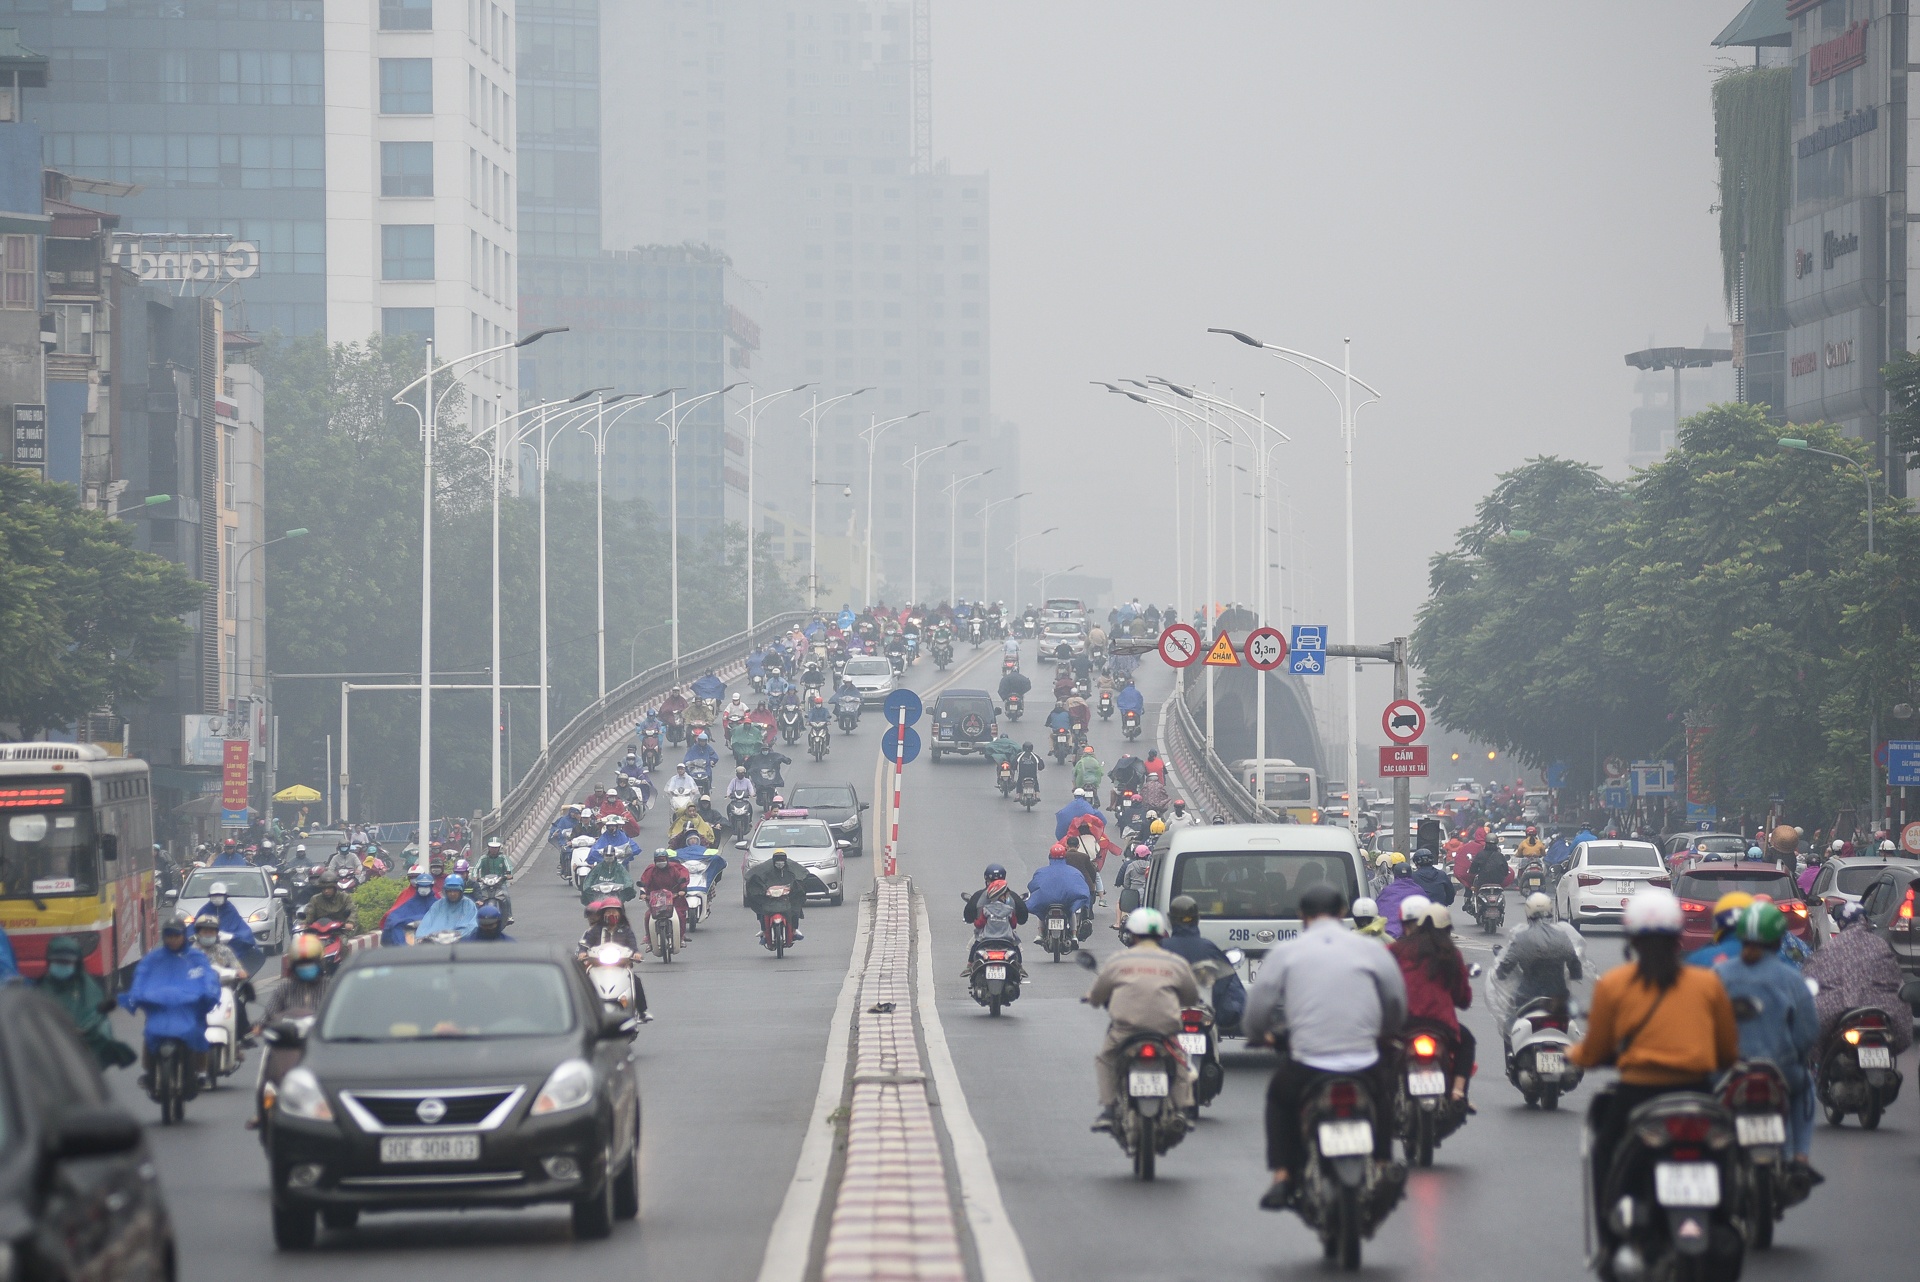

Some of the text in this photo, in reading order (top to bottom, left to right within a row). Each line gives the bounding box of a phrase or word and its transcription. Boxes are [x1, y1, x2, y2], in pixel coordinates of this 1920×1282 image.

[26, 424, 43, 440] NHẤT
[1254, 640, 1276, 658] 3,3m
[1212, 651, 1232, 662] CHẬM
[1394, 748, 1414, 761] CẤM
[1384, 762, 1426, 773] CÁC LOẠI XE TẢI
[54, 881, 71, 889] 22A
